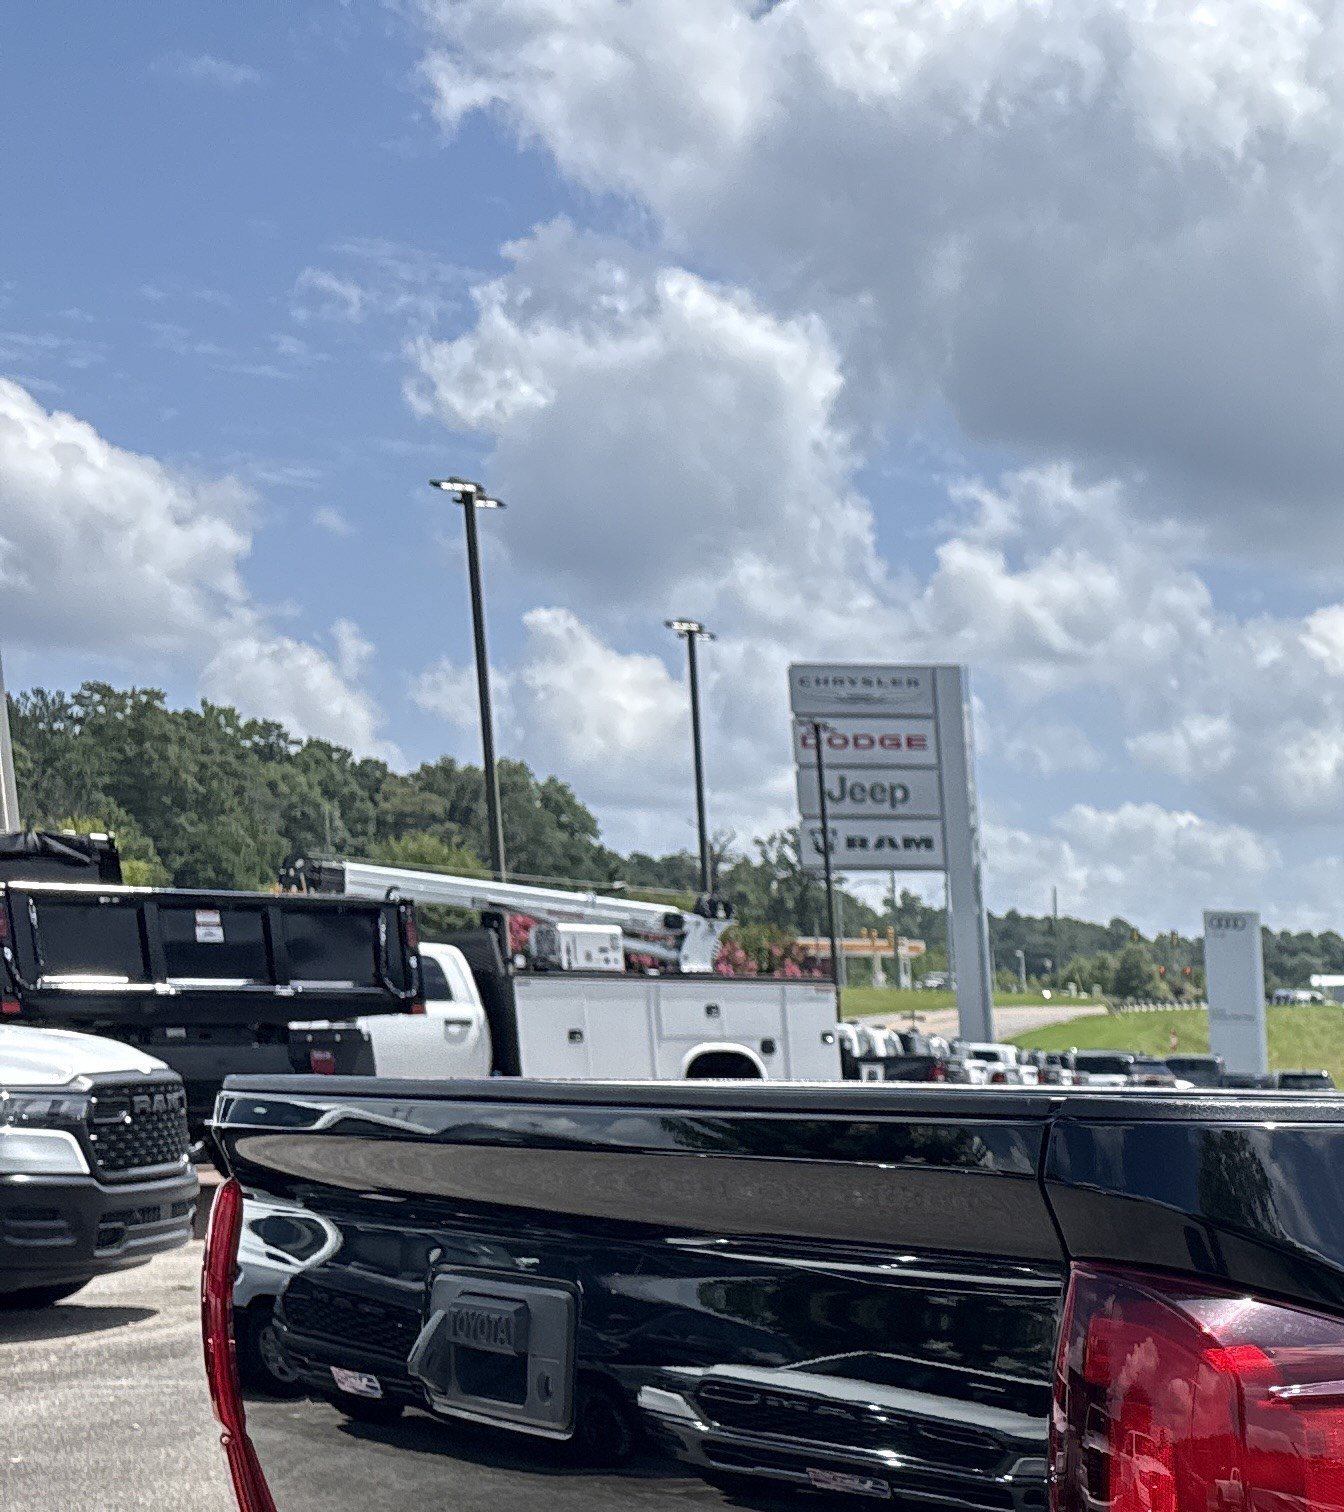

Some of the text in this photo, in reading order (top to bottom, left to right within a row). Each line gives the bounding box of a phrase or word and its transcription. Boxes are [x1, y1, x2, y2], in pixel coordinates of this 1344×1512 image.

[798, 675, 920, 689] CHRYSLER
[801, 733, 928, 751] DODGE
[827, 775, 910, 809] Jeep
[845, 834, 934, 850] RAM
[133, 1089, 187, 1113] RAM
[447, 1309, 514, 1346] TOYOTA
